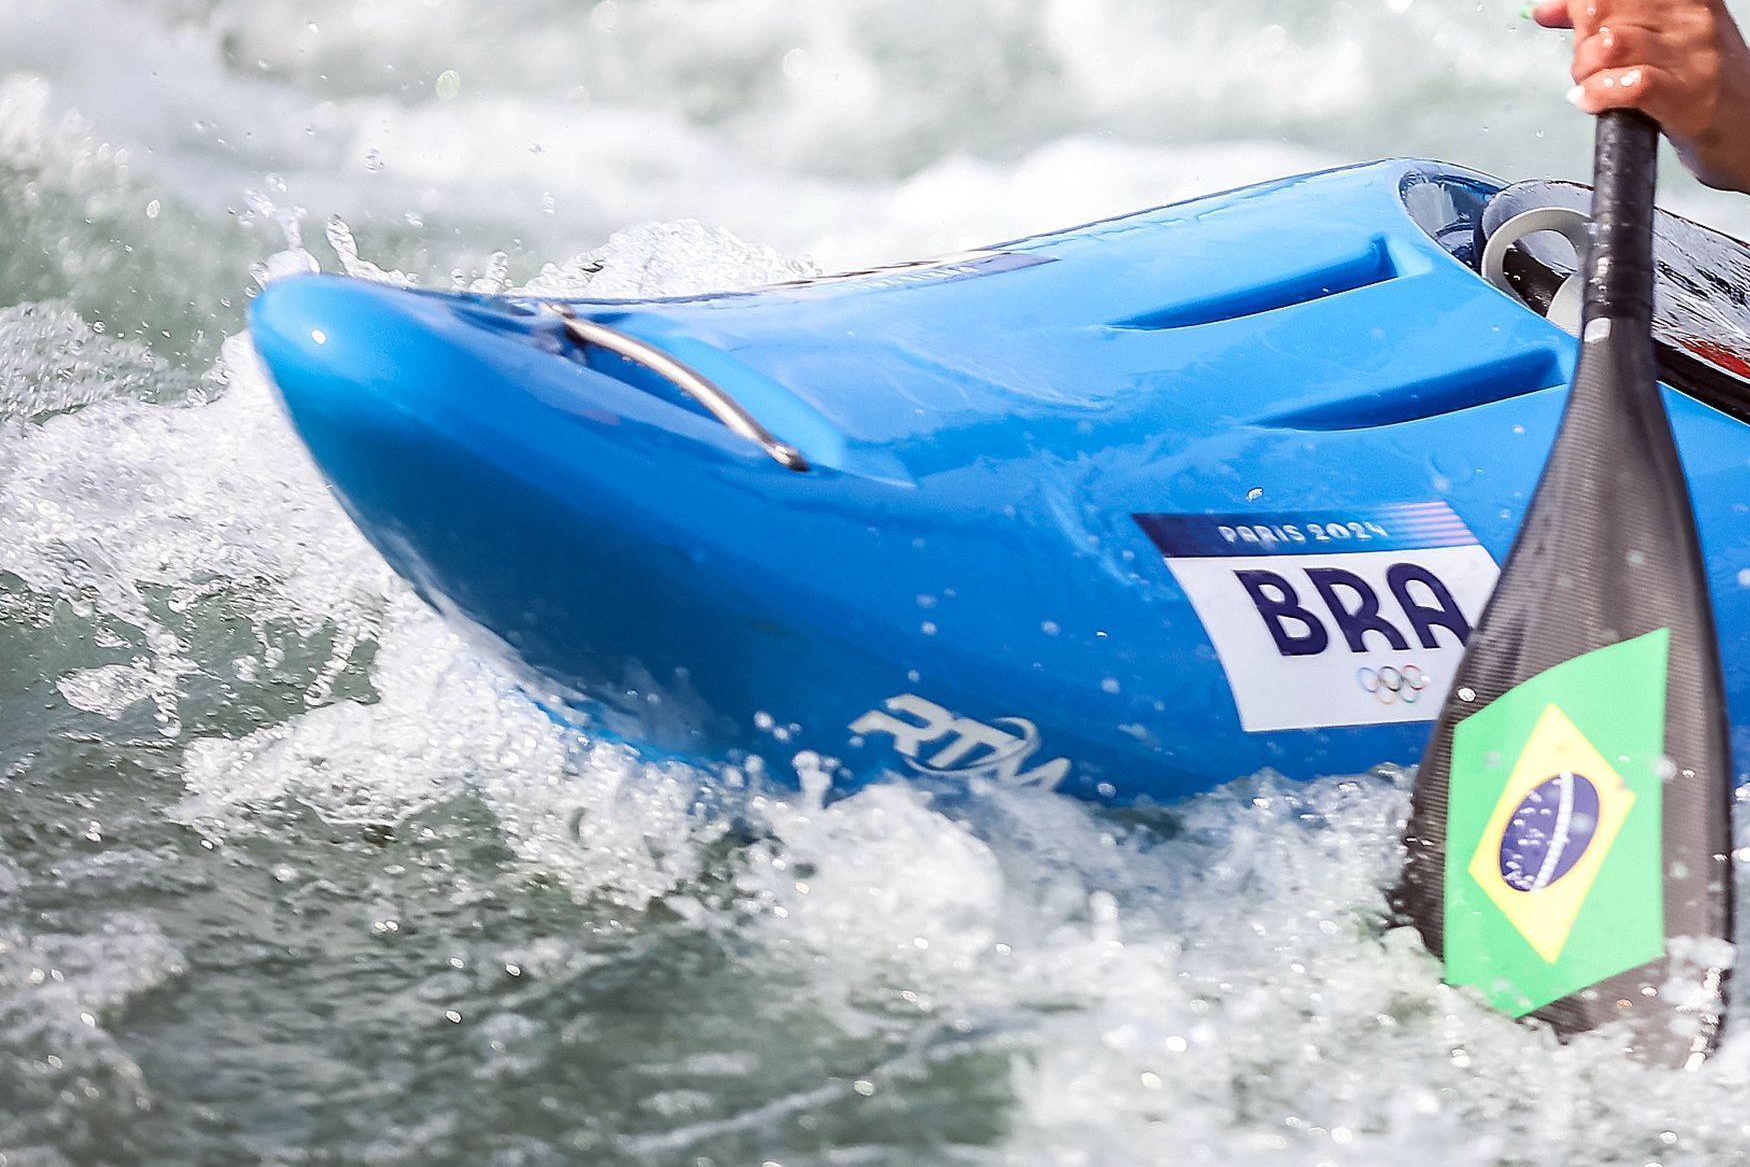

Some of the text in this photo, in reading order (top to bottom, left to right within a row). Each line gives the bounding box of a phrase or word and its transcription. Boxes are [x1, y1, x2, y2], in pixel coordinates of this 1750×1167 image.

[1217, 520, 1390, 545] PARIS 2024
[1232, 562, 1476, 657] BRA
